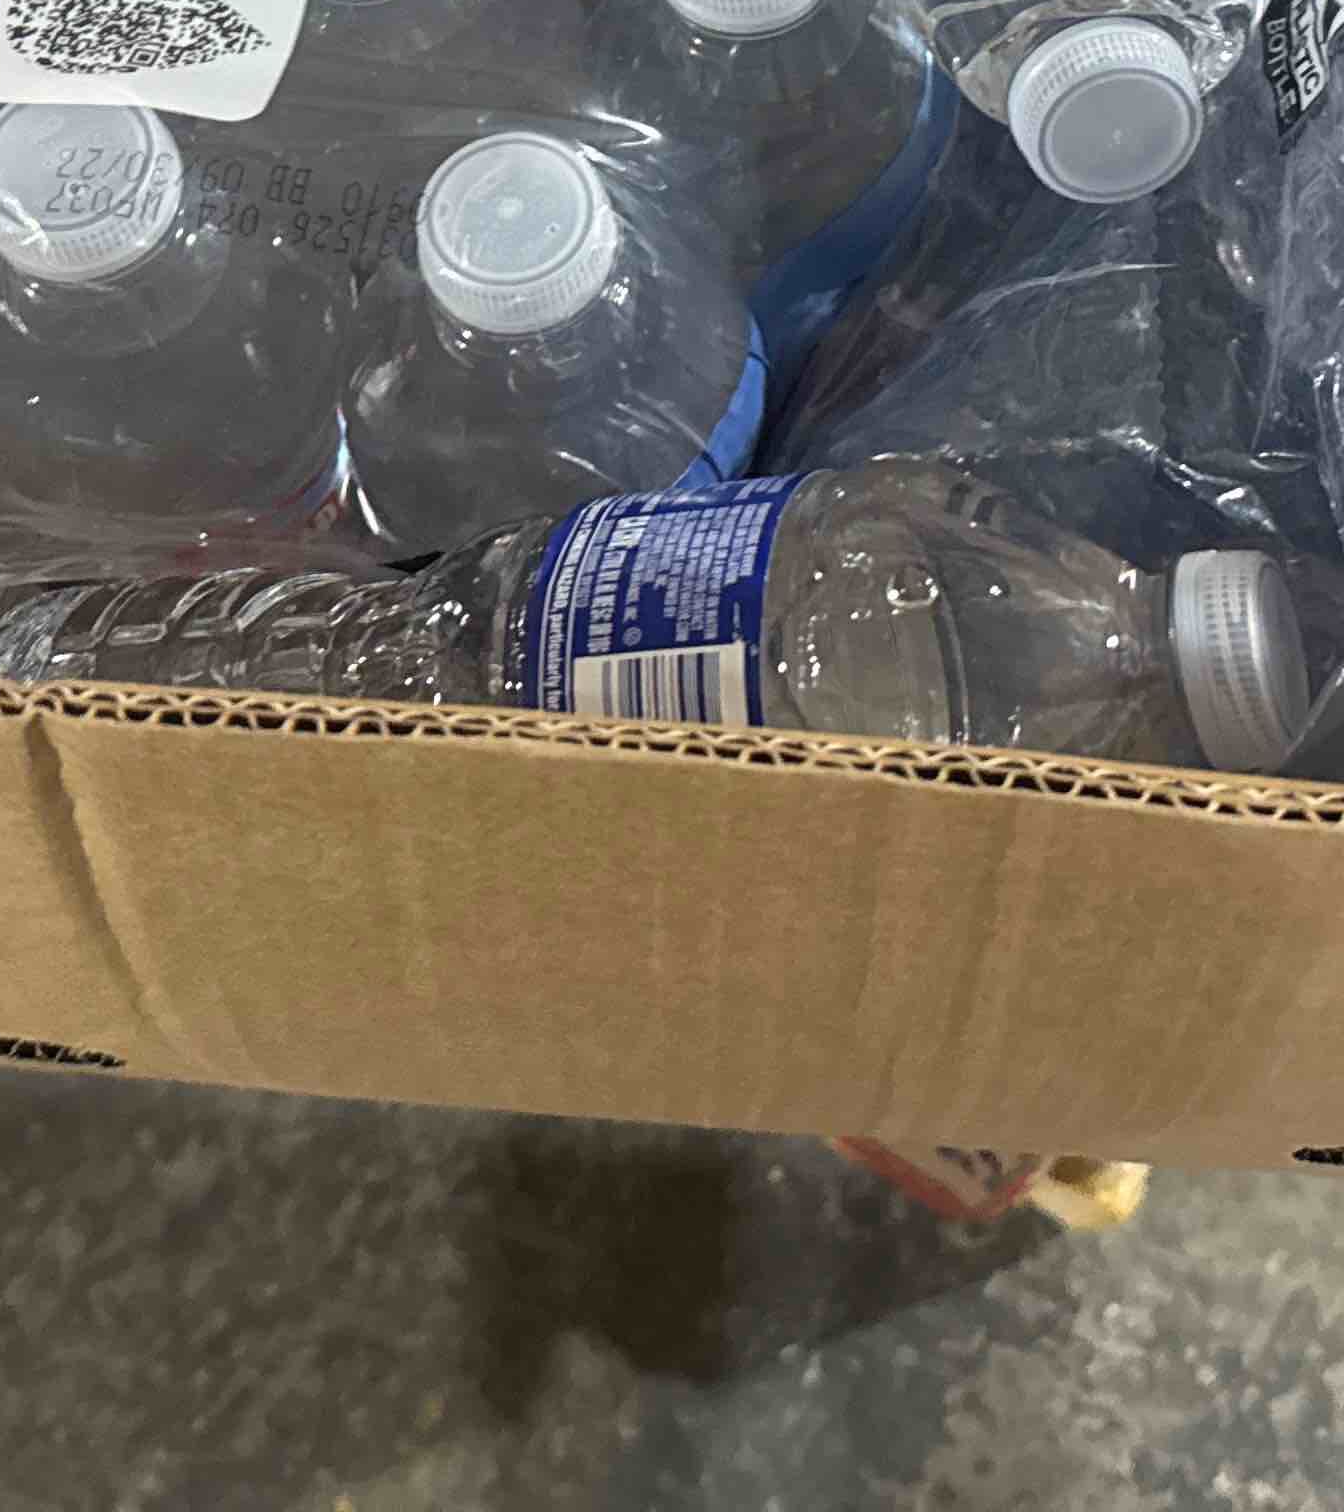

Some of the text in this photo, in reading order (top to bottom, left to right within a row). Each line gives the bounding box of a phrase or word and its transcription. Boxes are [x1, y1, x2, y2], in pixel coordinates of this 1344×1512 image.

[1266, 16, 1299, 118] BOTTLE
[267, 165, 312, 205] BB
[551, 566, 578, 611] HAZARD,
[542, 614, 565, 687] particularly
[546, 690, 563, 710] for
